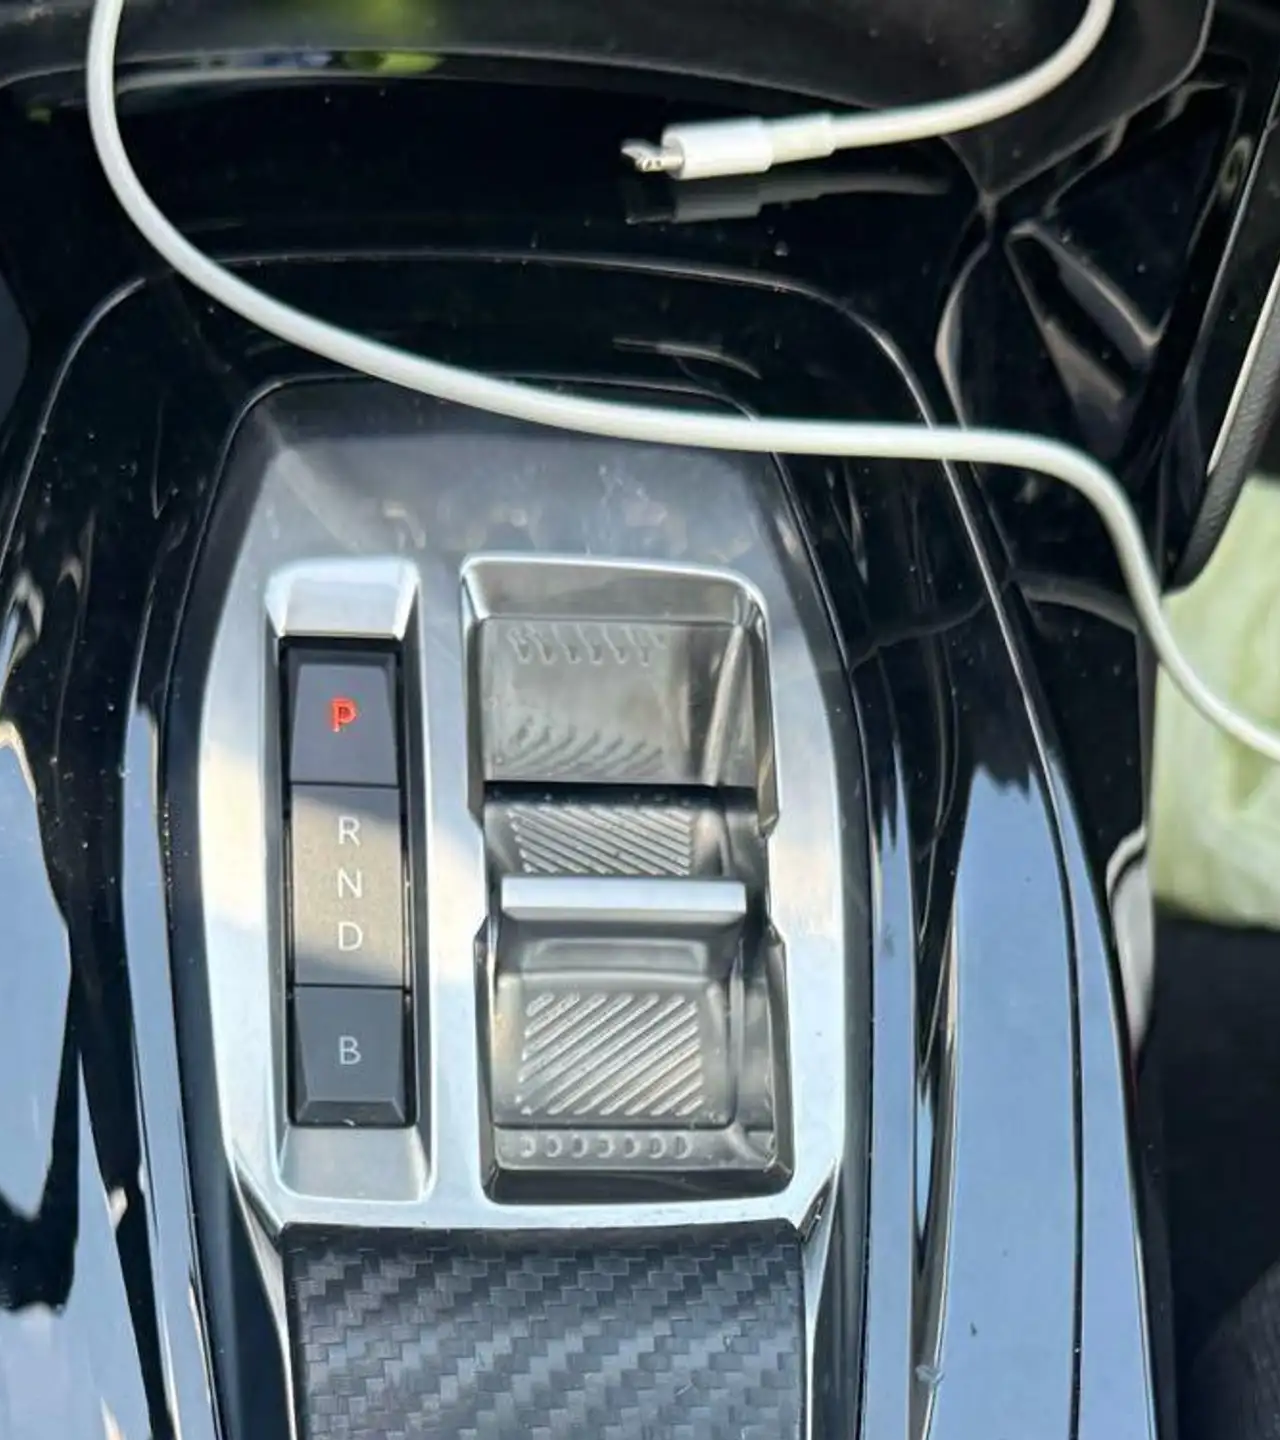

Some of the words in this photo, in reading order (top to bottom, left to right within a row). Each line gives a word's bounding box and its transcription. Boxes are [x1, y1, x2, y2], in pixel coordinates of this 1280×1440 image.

[330, 698, 358, 732] P
[338, 816, 361, 846] R
[337, 868, 362, 899] N
[338, 922, 364, 951] D
[339, 1036, 362, 1066] B
